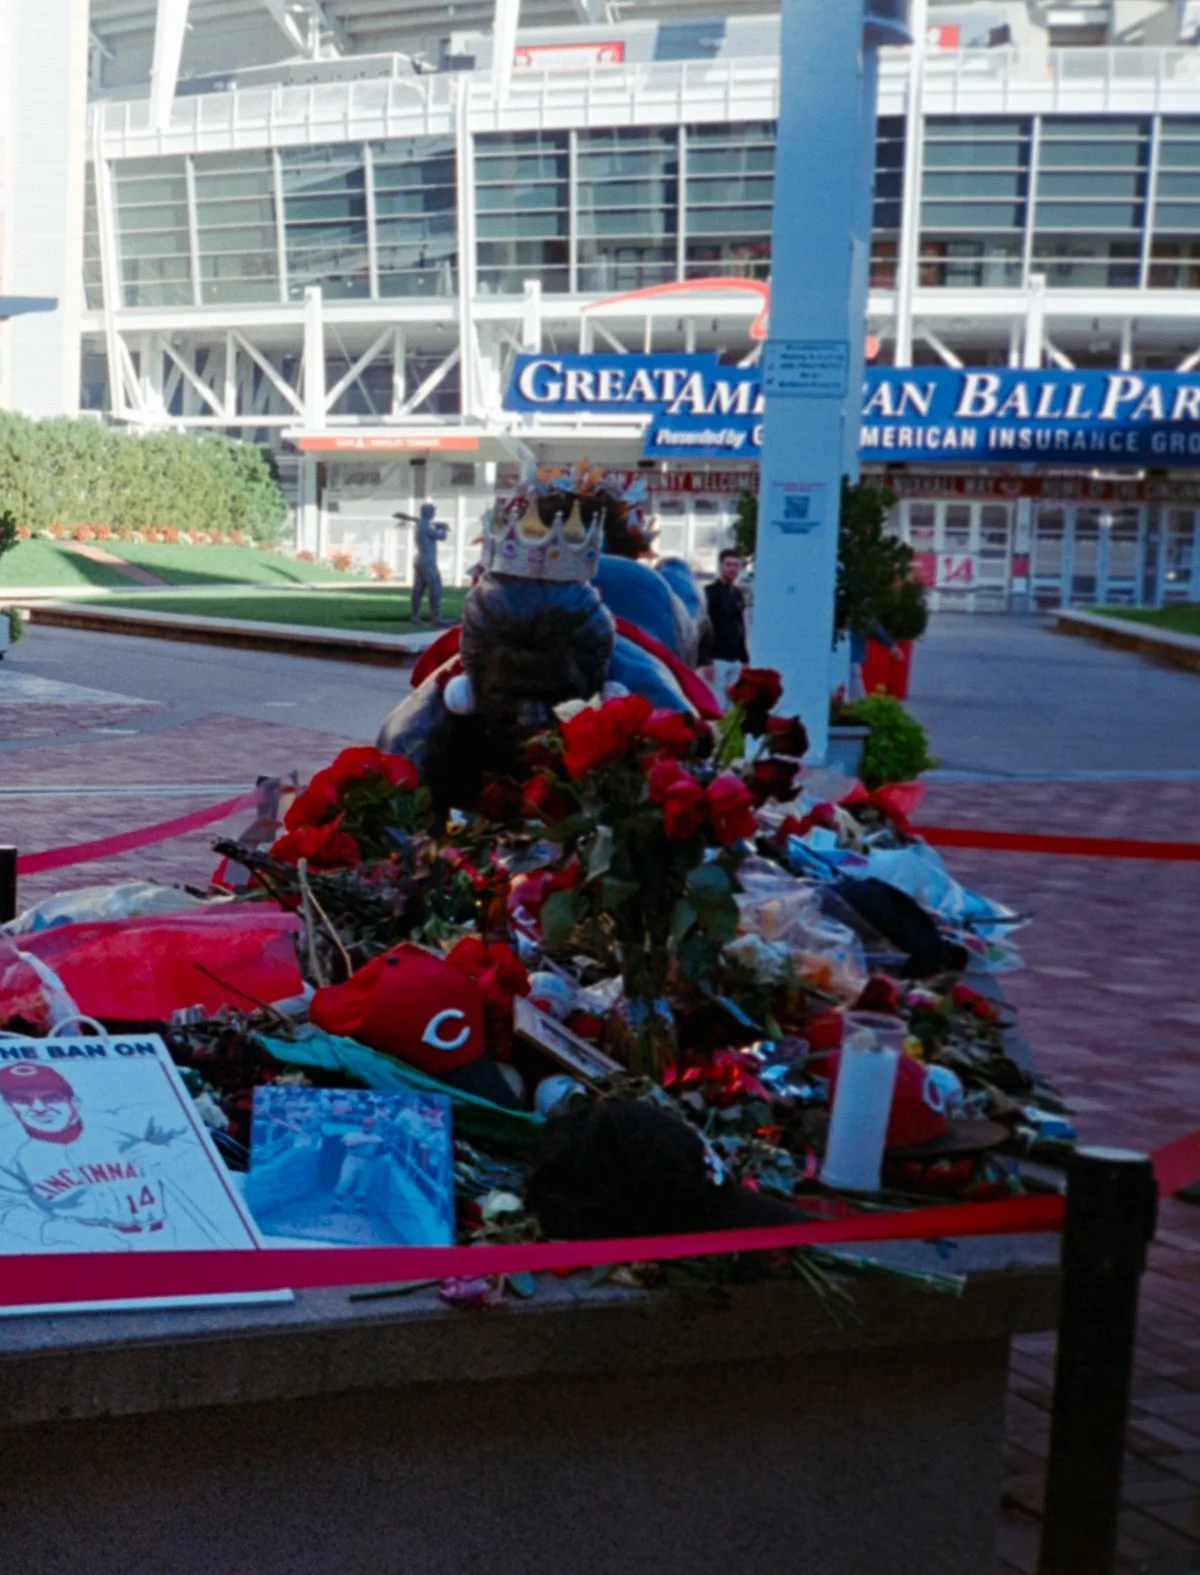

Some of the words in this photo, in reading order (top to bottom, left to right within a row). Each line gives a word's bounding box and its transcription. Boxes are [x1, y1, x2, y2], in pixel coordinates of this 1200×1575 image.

[518, 359, 687, 402] GREAT
[953, 372, 1092, 418] BALL
[859, 425, 977, 449] MERICAN
[987, 426, 1141, 452] INSURANCE
[420, 1007, 471, 1050] C
[46, 1043, 107, 1059] BAN
[114, 1041, 158, 1057] ON
[34, 1161, 139, 1201] INCINNA
[126, 1184, 157, 1215] 14
